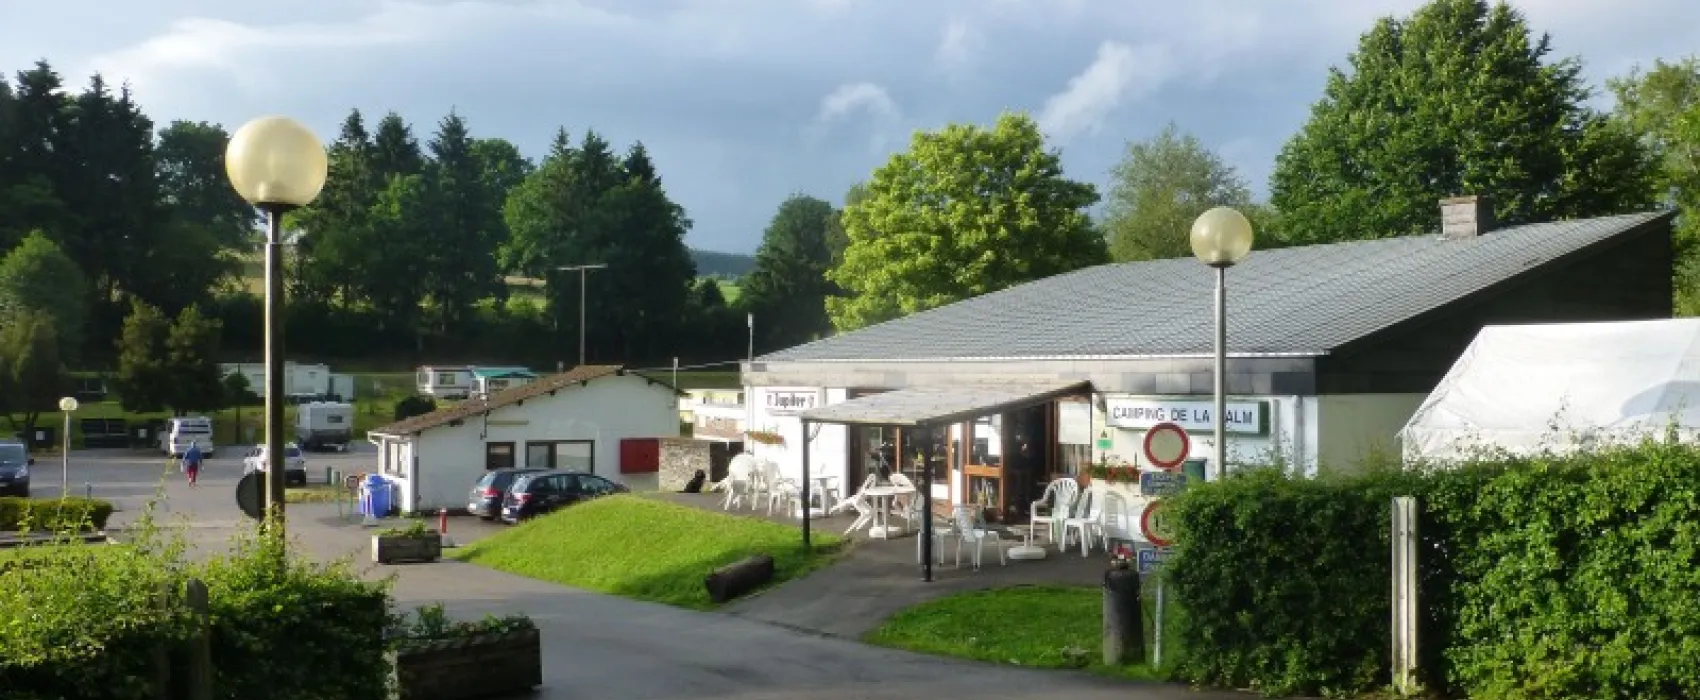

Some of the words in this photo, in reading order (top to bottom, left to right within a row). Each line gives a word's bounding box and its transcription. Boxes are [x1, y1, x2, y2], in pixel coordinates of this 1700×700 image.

[1113, 406, 1165, 421] CAMPING
[1171, 408, 1188, 422] DE
[1193, 409, 1210, 424] LA
[1223, 410, 1253, 425] ALM
